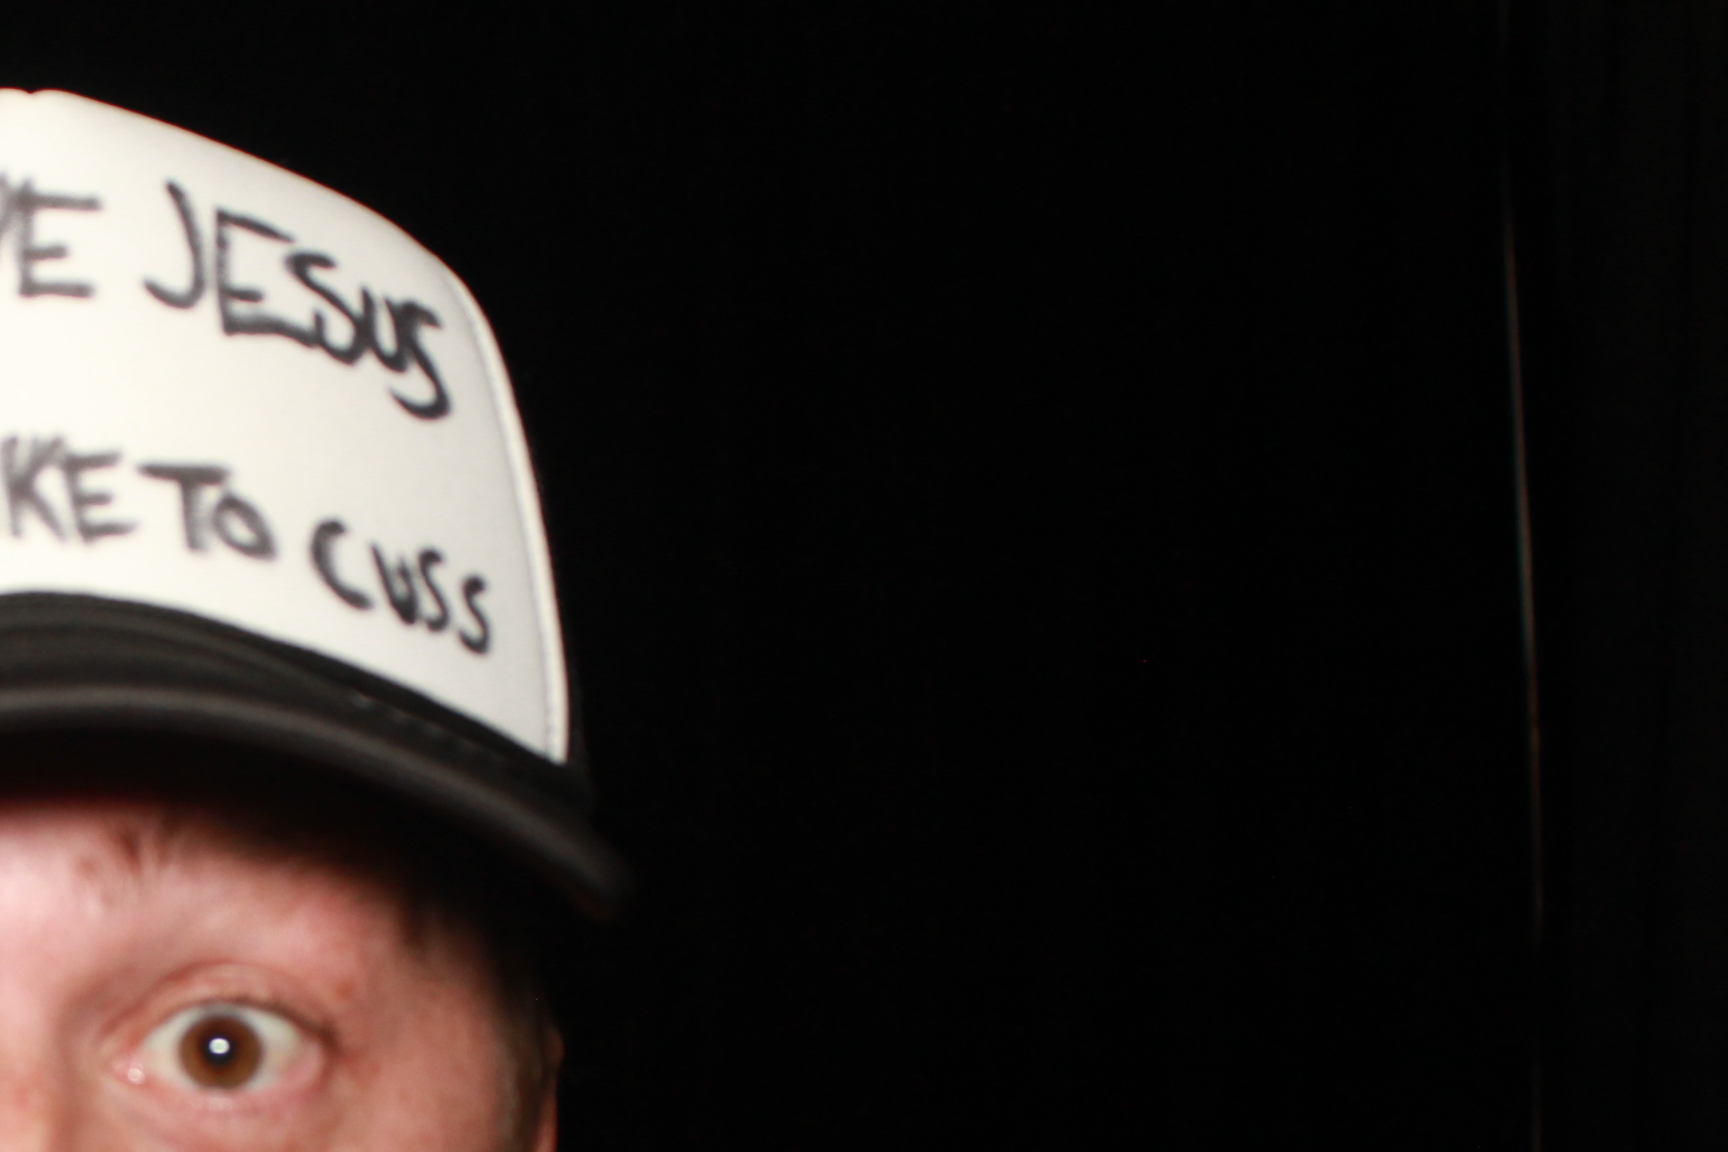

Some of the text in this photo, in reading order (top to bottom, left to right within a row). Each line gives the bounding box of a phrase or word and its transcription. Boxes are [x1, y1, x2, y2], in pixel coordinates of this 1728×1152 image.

[142, 177, 453, 421] JESUS
[138, 459, 276, 560] TO
[309, 516, 492, 656] CUSS
